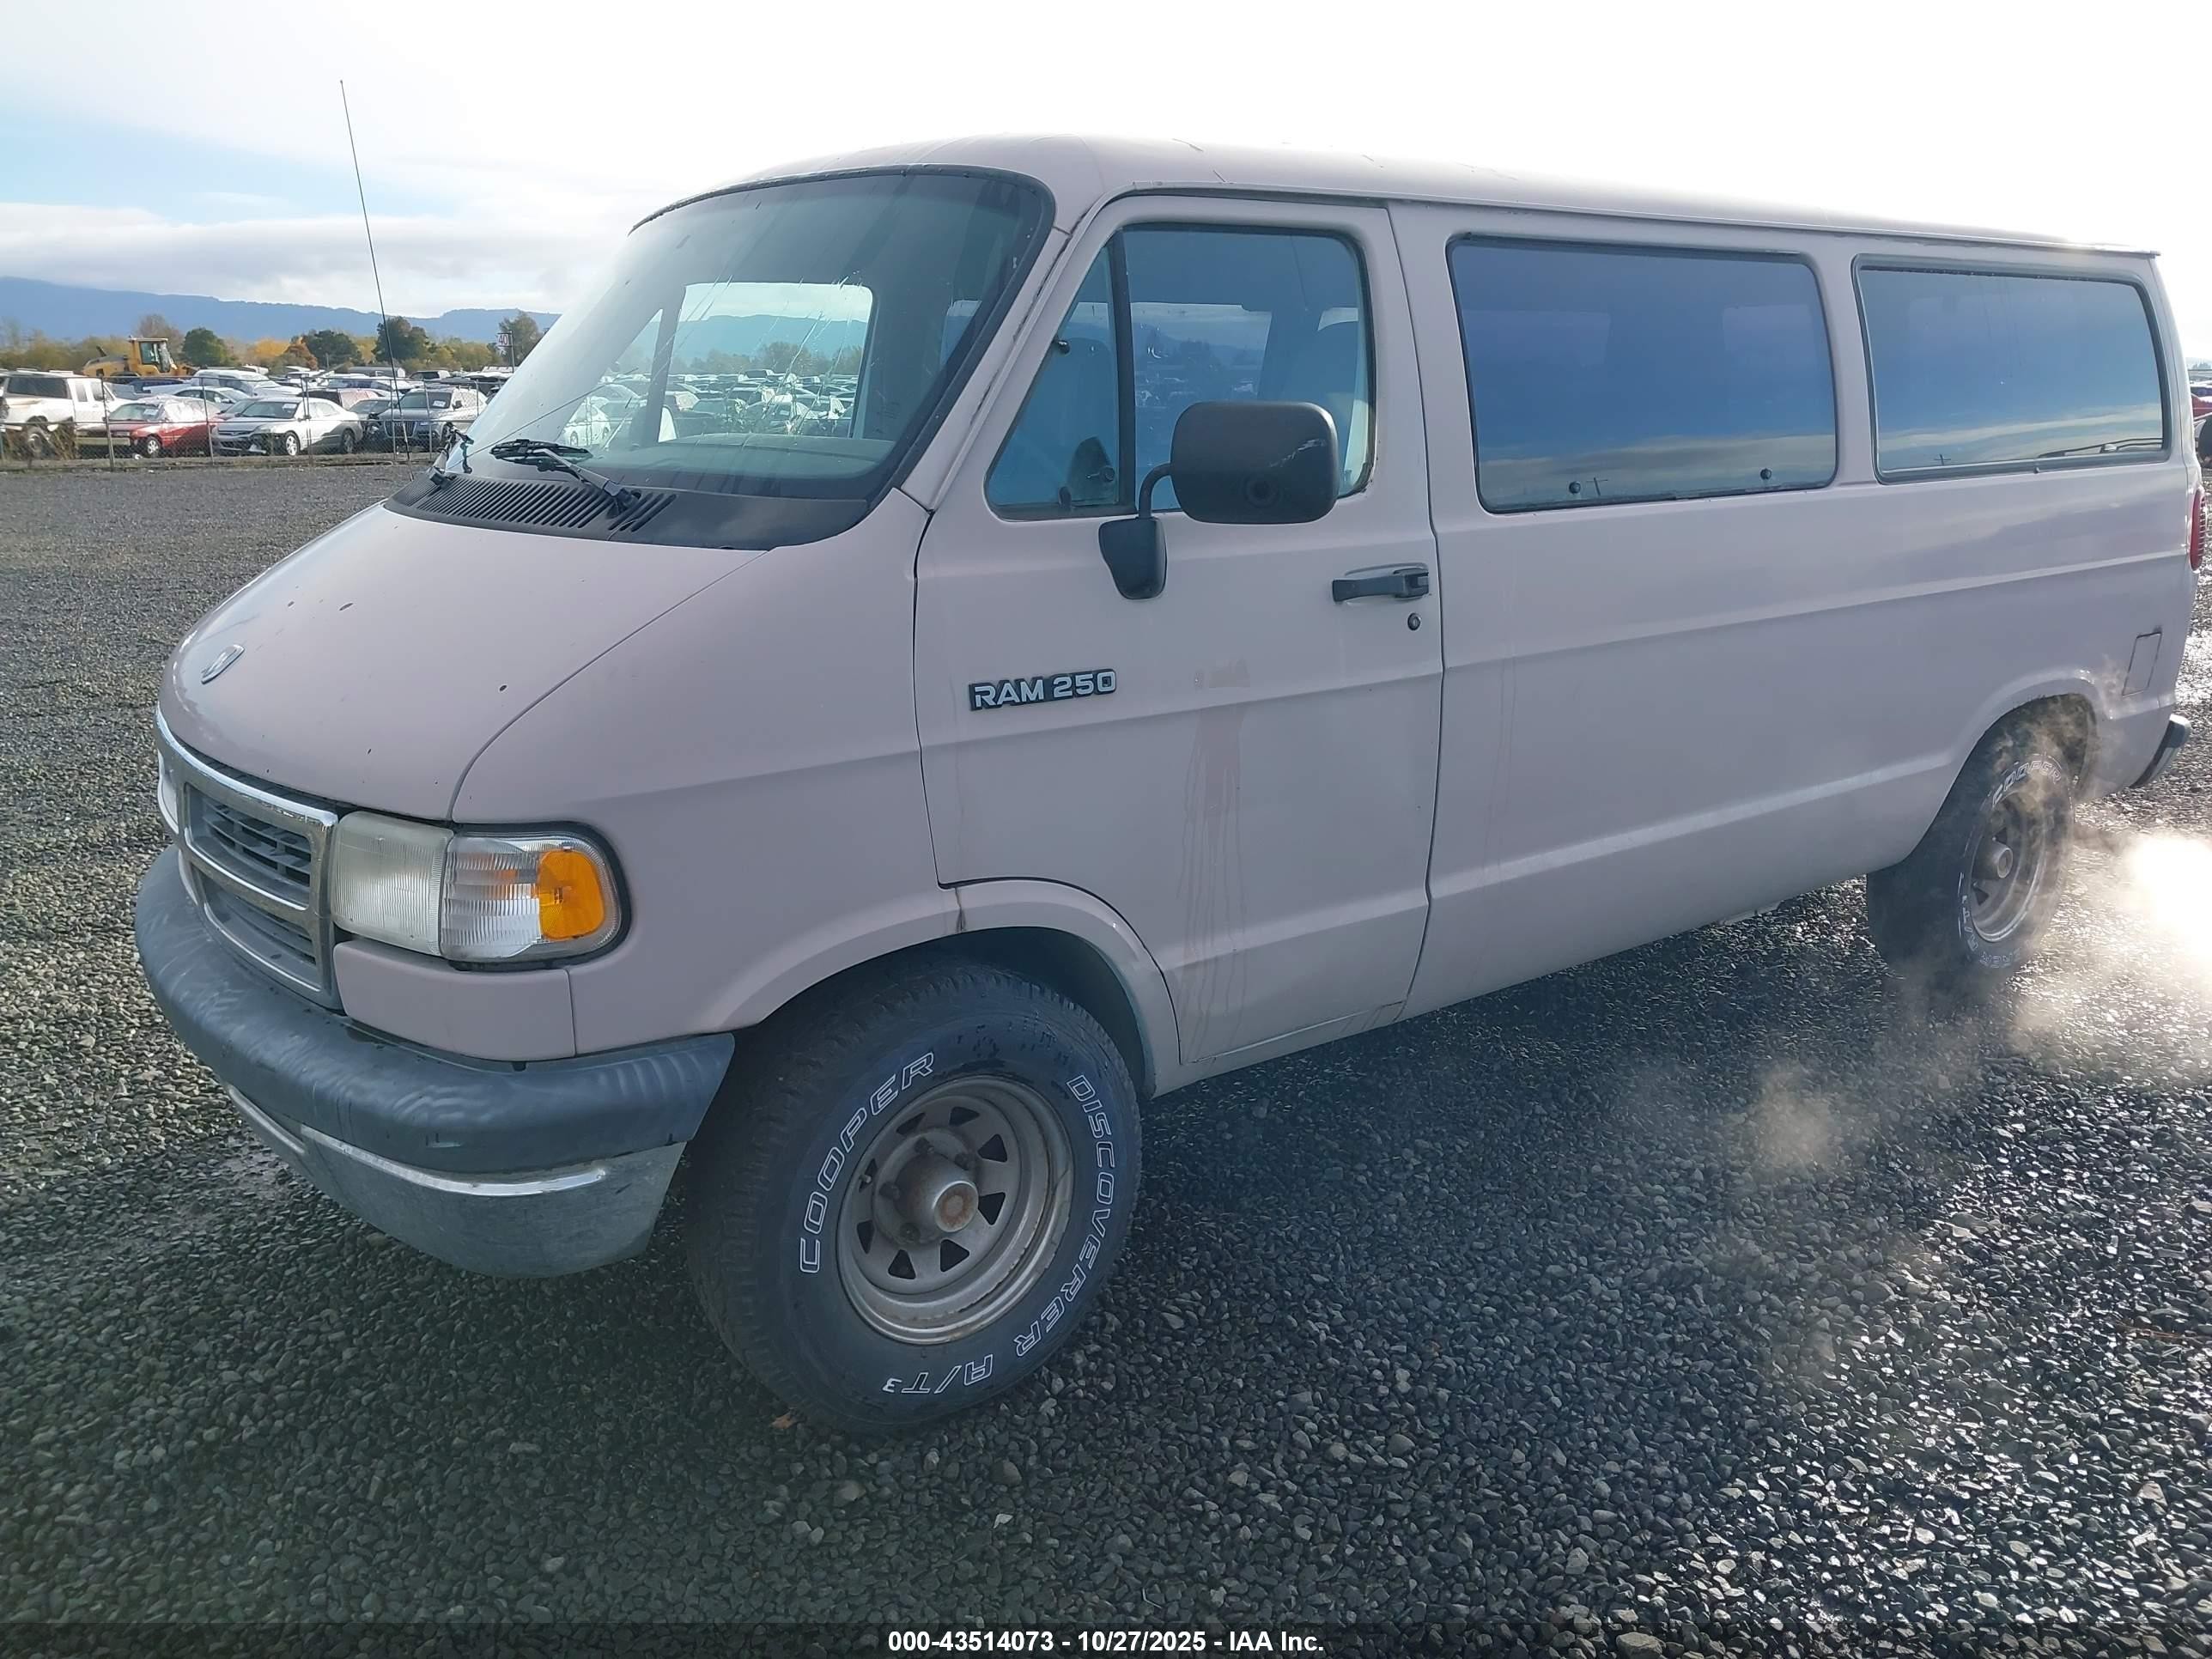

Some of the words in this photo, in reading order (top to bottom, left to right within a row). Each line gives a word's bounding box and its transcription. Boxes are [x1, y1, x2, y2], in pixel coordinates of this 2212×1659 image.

[972, 678, 1045, 709] RAM
[1052, 670, 1116, 699] 250
[799, 1051, 936, 1274] COOPER
[1012, 1073, 1116, 1358] DISCOVERER
